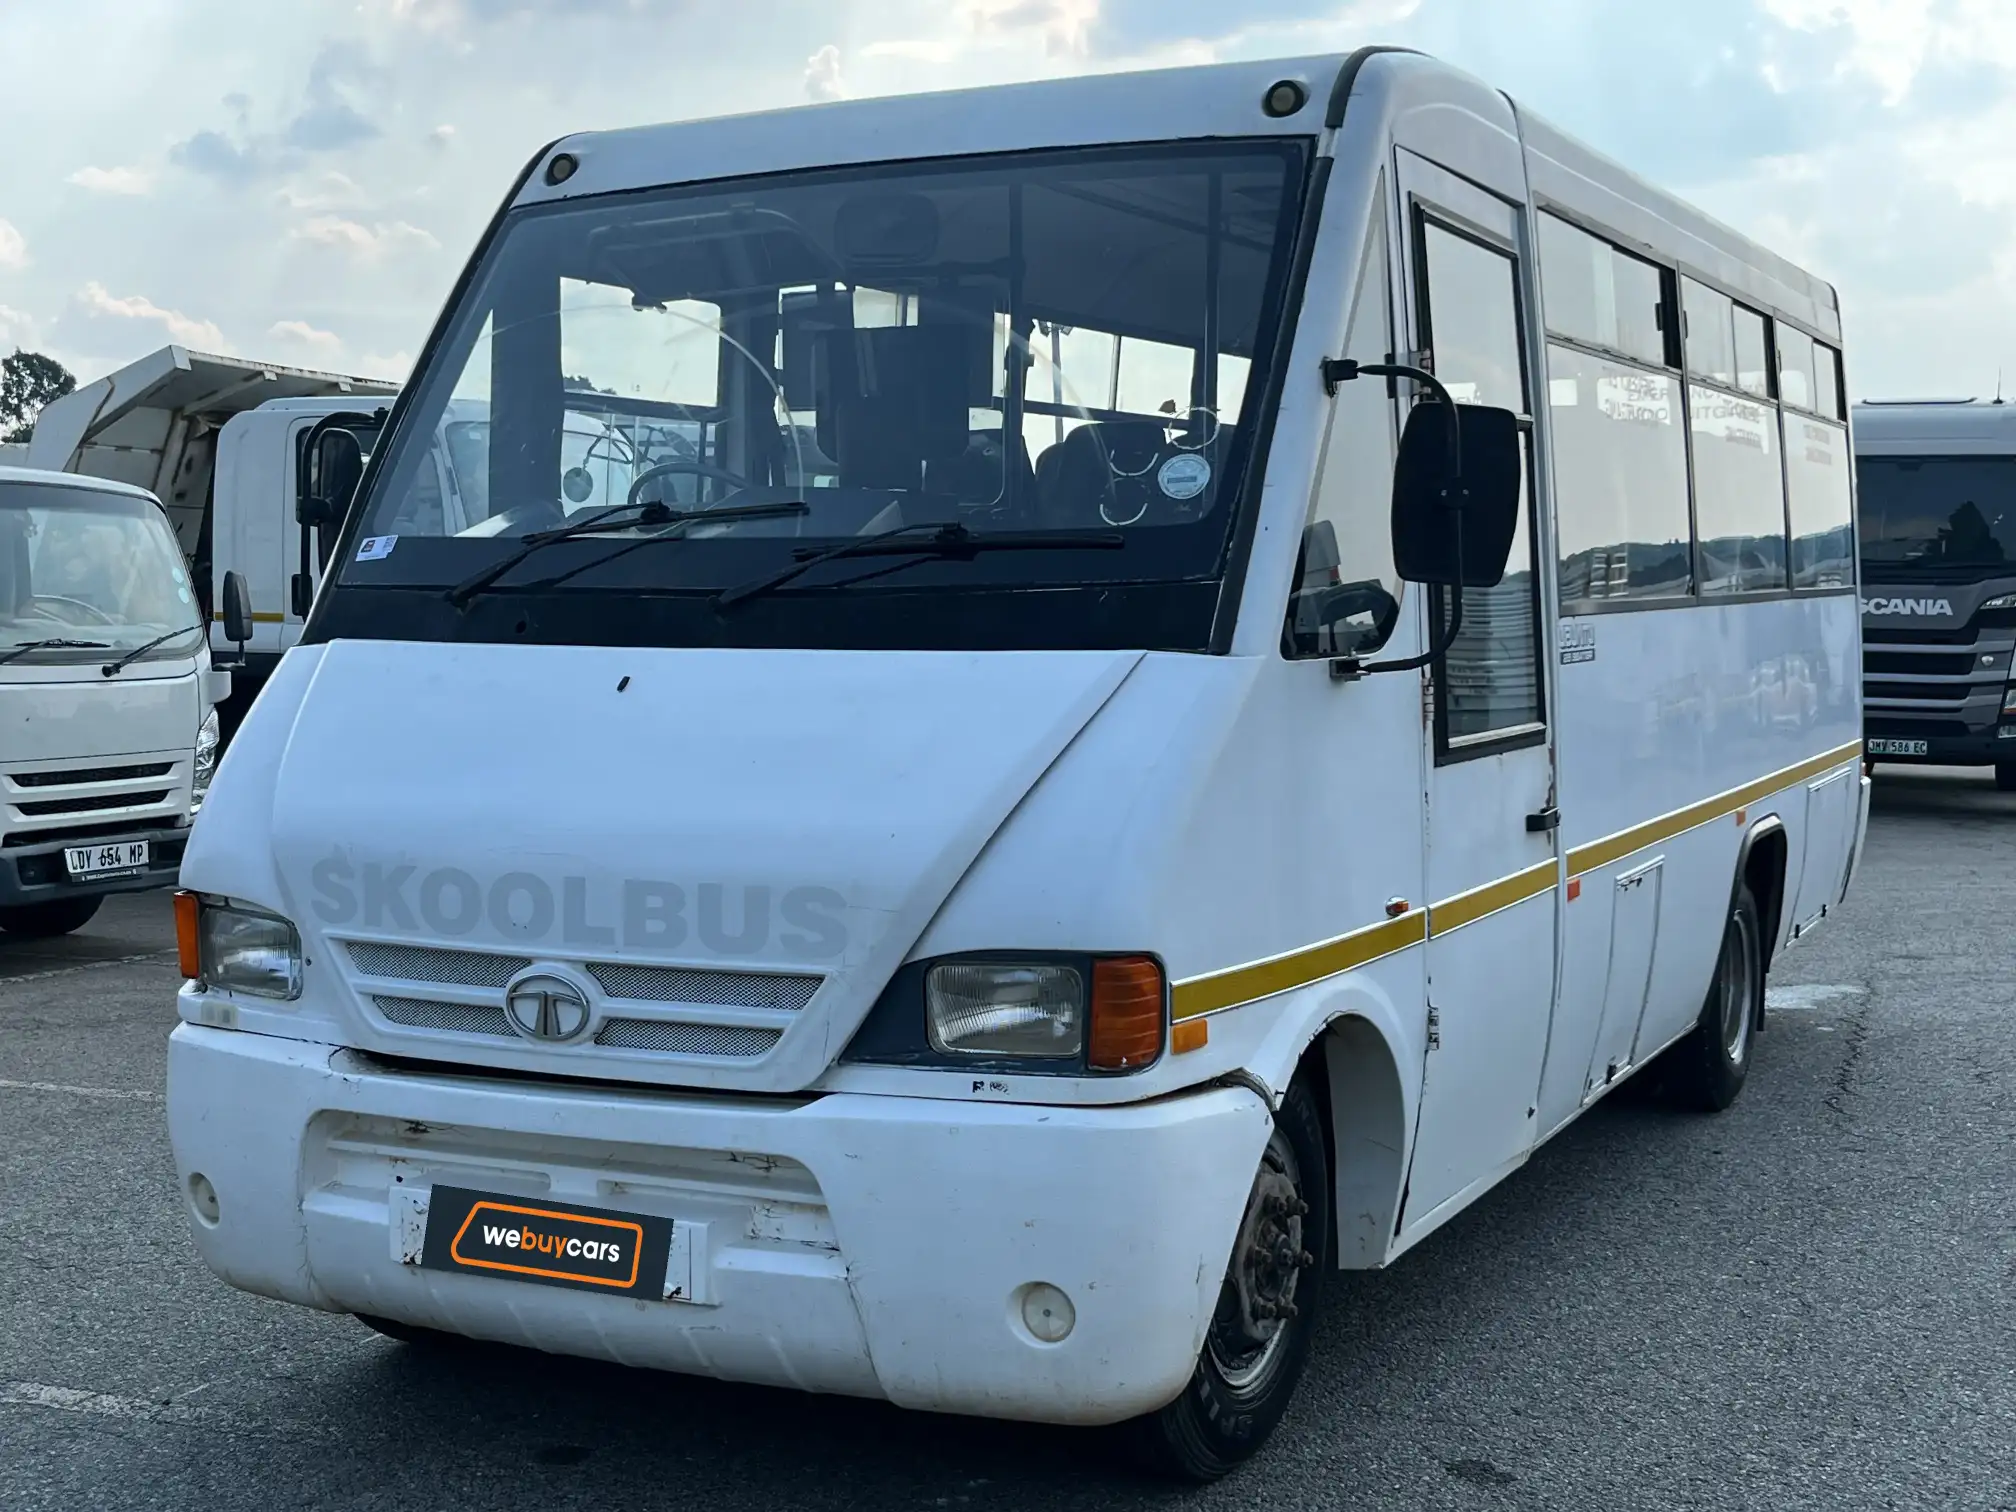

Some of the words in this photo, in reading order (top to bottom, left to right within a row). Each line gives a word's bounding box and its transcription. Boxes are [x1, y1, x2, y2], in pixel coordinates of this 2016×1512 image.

[1891, 741, 1910, 753] 586
[1913, 742, 1926, 754] EC
[99, 846, 122, 867] 654
[129, 844, 144, 864] MP
[310, 857, 849, 958] SKOOLBUS
